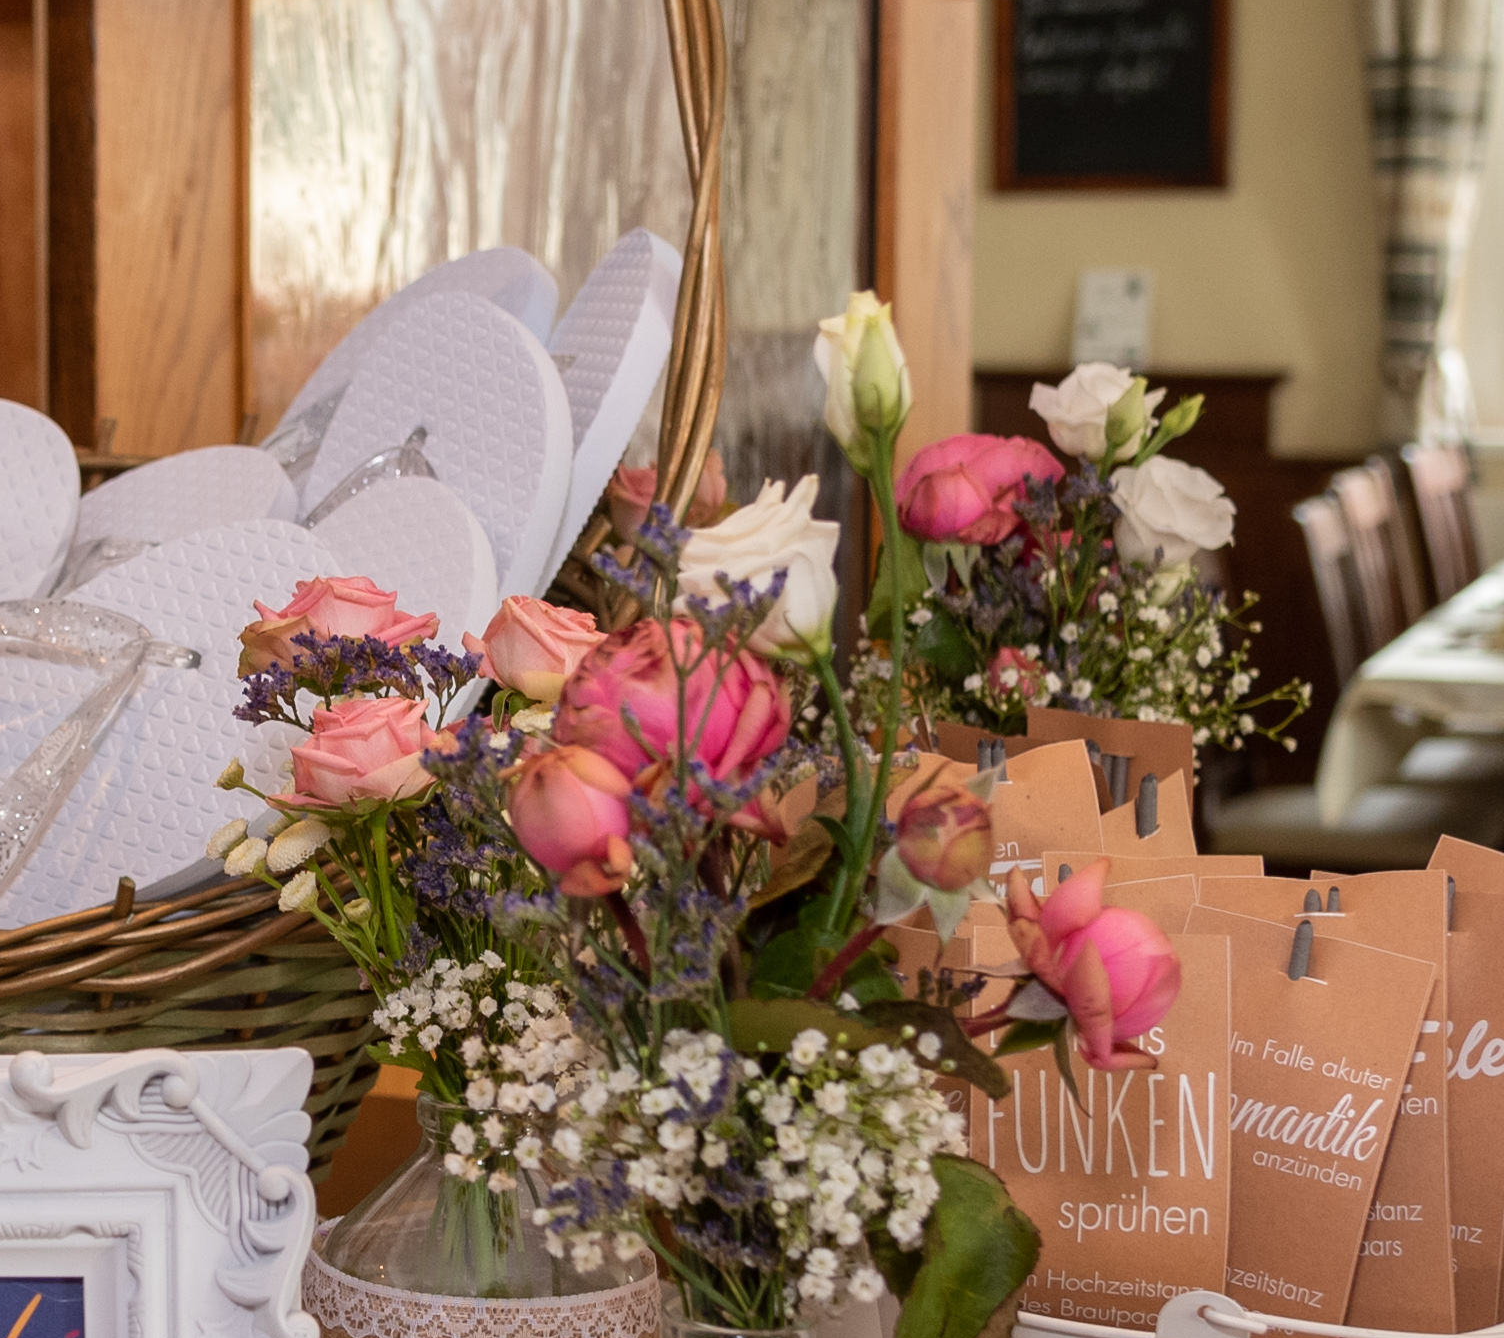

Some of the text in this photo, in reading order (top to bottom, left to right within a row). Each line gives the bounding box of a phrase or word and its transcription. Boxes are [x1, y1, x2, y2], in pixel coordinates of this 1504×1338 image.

[1229, 1031, 1254, 1056] Im
[1262, 1038, 1315, 1072] Falle
[1322, 1057, 1392, 1092] akuter
[988, 1068, 1215, 1179] FUNKEN
[1230, 1093, 1384, 1162] mantik
[1252, 1150, 1362, 1191] anzünden
[1057, 1186, 1208, 1243] sprühen
[1226, 1264, 1324, 1308] zeitstanz
